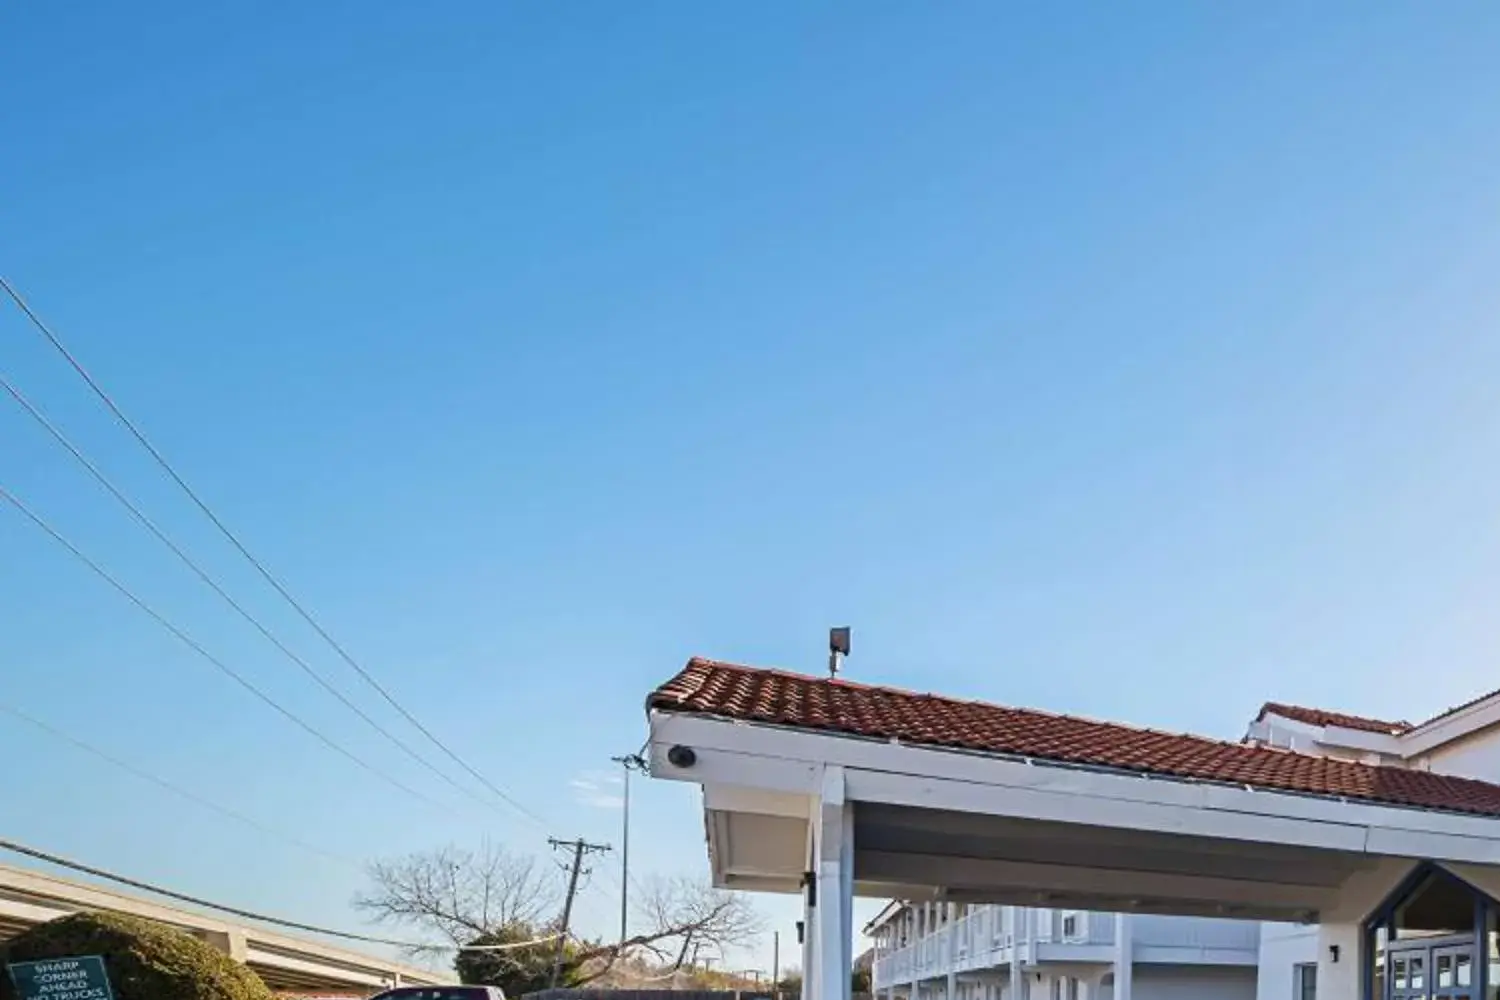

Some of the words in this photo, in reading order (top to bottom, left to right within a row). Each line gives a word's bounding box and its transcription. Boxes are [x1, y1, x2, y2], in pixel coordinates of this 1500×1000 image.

[34, 961, 79, 973] SHARP
[33, 970, 88, 984] CORNER
[39, 981, 88, 994] AHEAD
